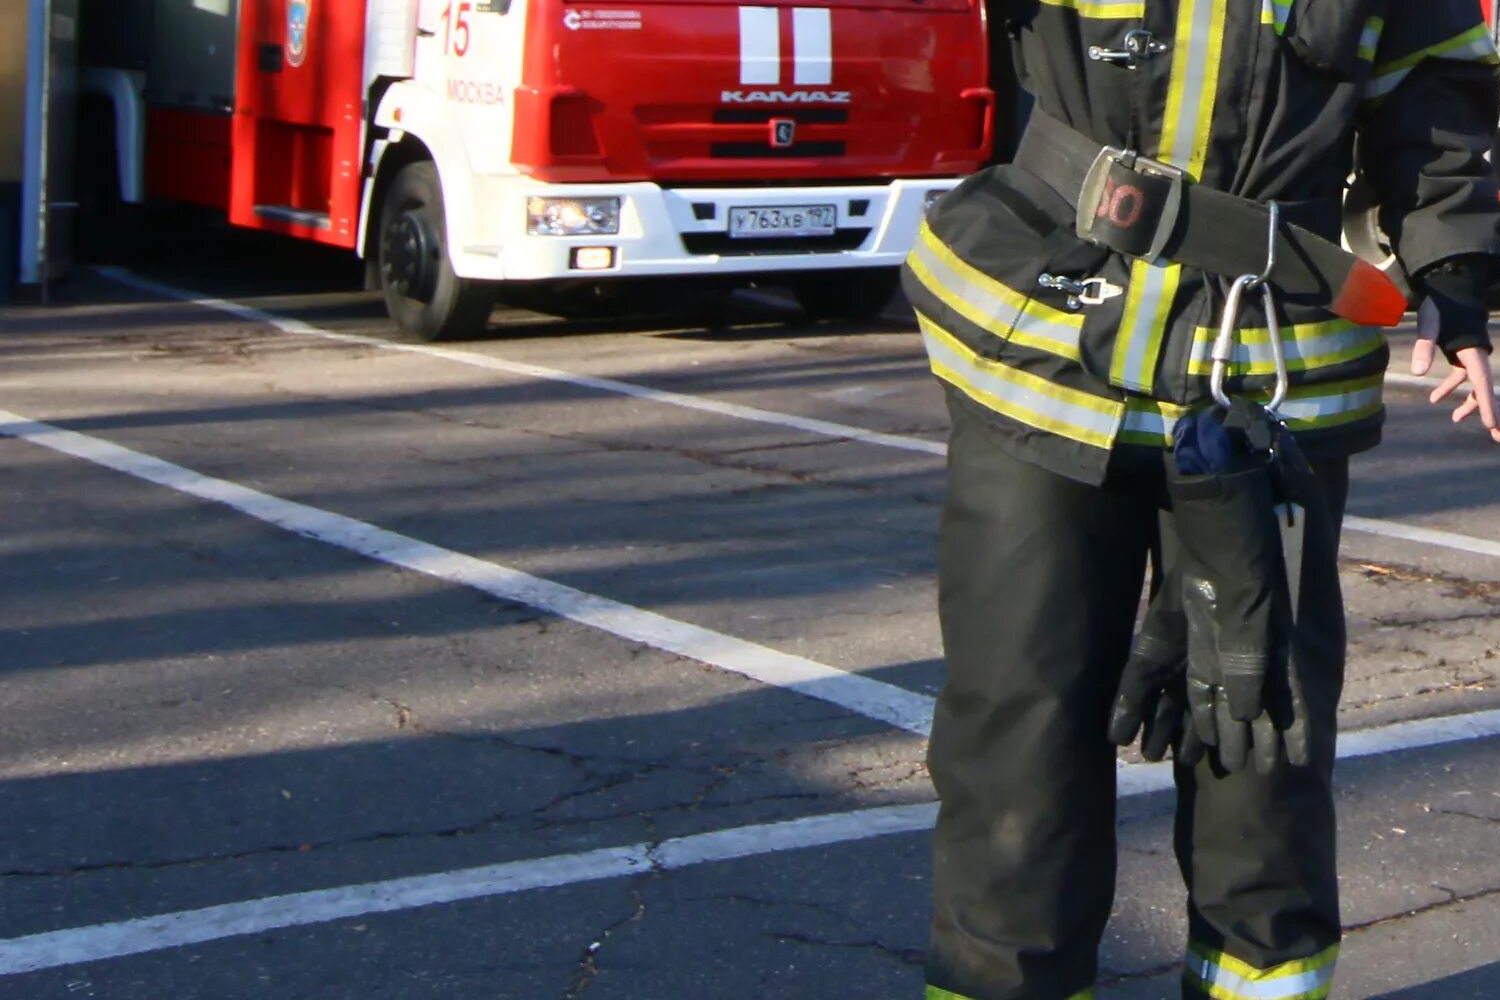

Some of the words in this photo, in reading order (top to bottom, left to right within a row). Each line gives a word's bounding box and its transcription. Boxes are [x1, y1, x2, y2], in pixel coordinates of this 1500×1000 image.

[441, 0, 471, 57] 15
[447, 78, 505, 106] МОСКВА
[721, 90, 852, 103] KAMAZ
